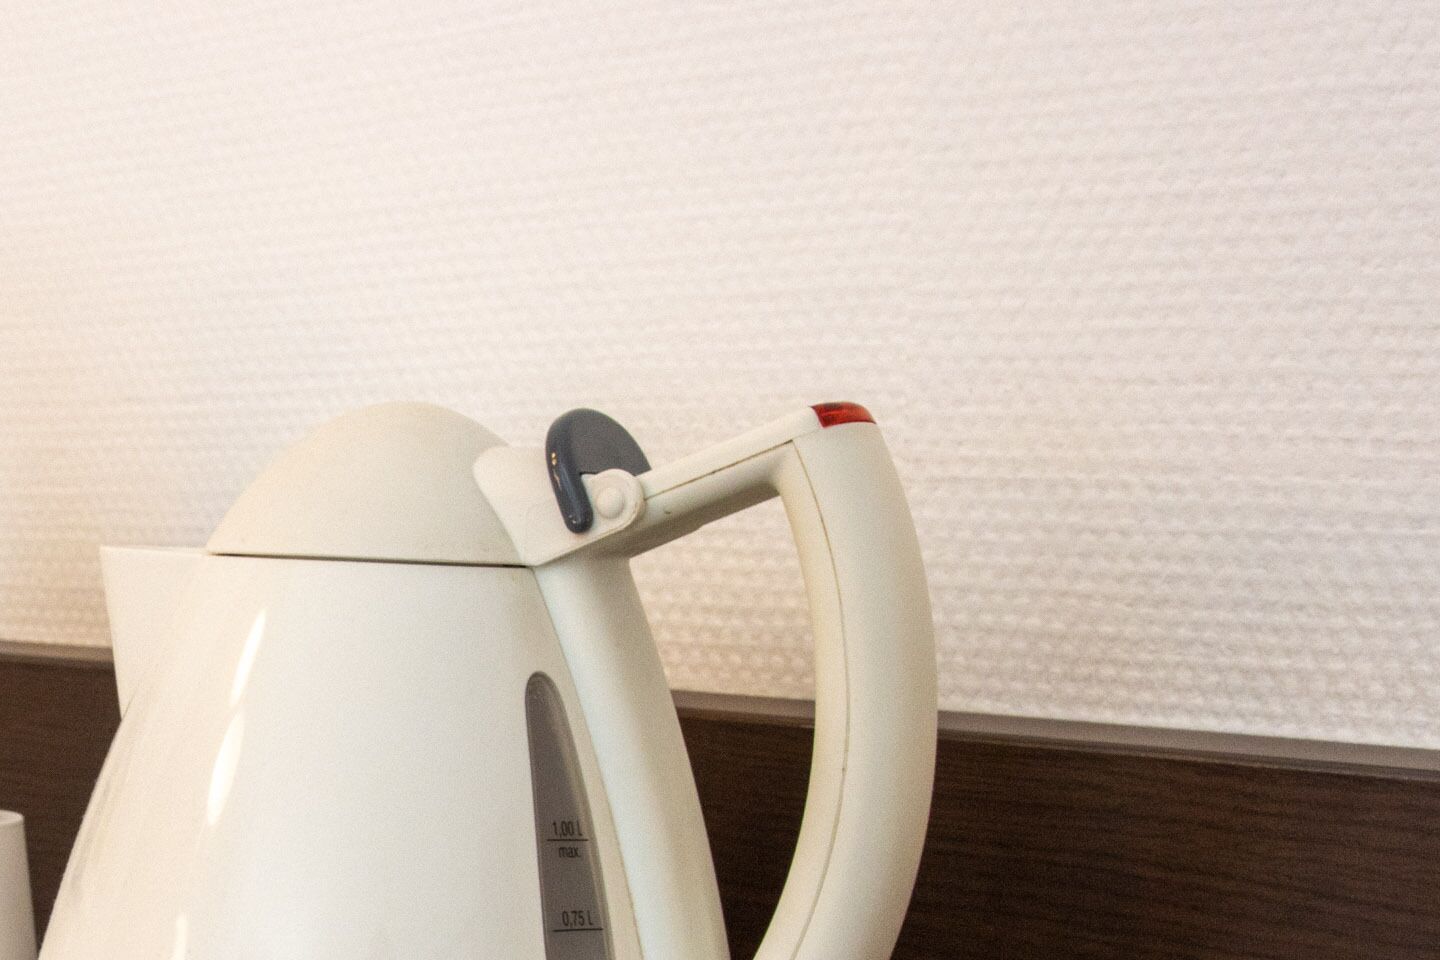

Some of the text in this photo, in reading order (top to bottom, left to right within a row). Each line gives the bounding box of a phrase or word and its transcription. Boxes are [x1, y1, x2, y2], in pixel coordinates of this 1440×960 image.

[552, 820, 583, 838] 1,00 L
[562, 910, 594, 928] 0,75 L
